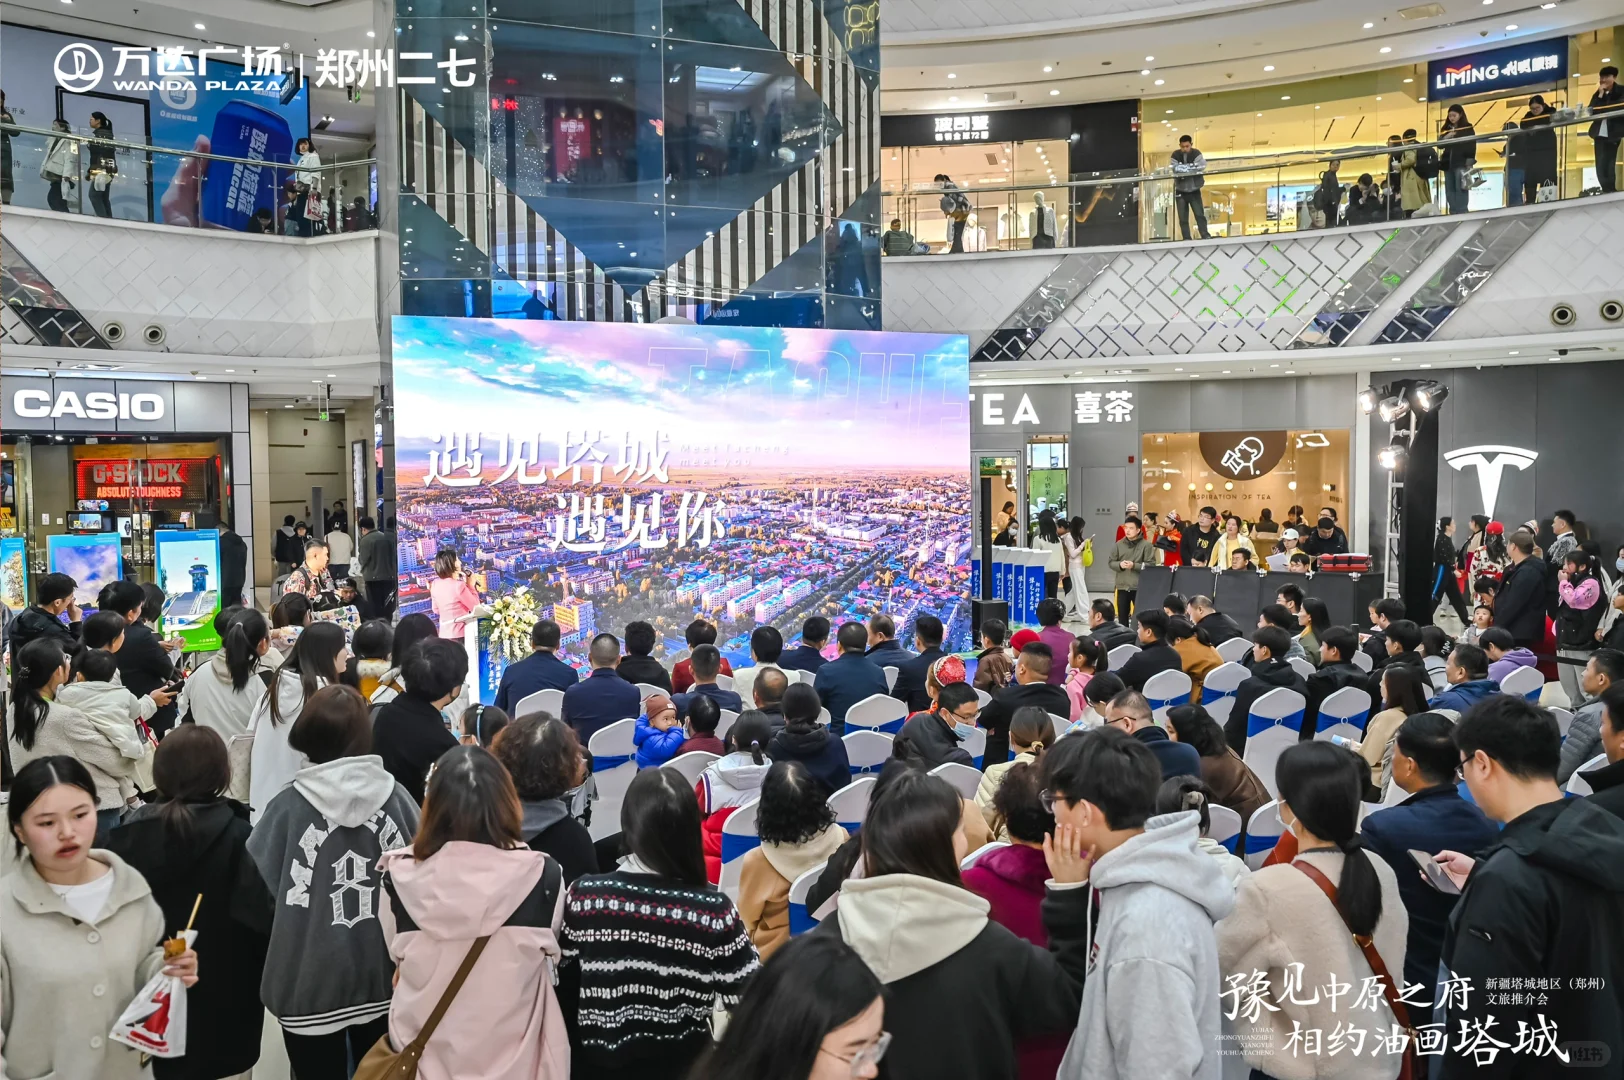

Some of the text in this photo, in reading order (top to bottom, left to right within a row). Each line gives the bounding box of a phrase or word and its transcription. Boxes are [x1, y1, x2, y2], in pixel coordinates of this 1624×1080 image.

[1436, 63, 1499, 89] LIMING
[13, 389, 165, 420] CASIO
[1074, 390, 1135, 424] 喜茶
[93, 463, 183, 484] G-SHOCK
[422, 429, 670, 489] 遇见塔城
[549, 491, 727, 554] 遇见你
[329, 849, 375, 929] 8
